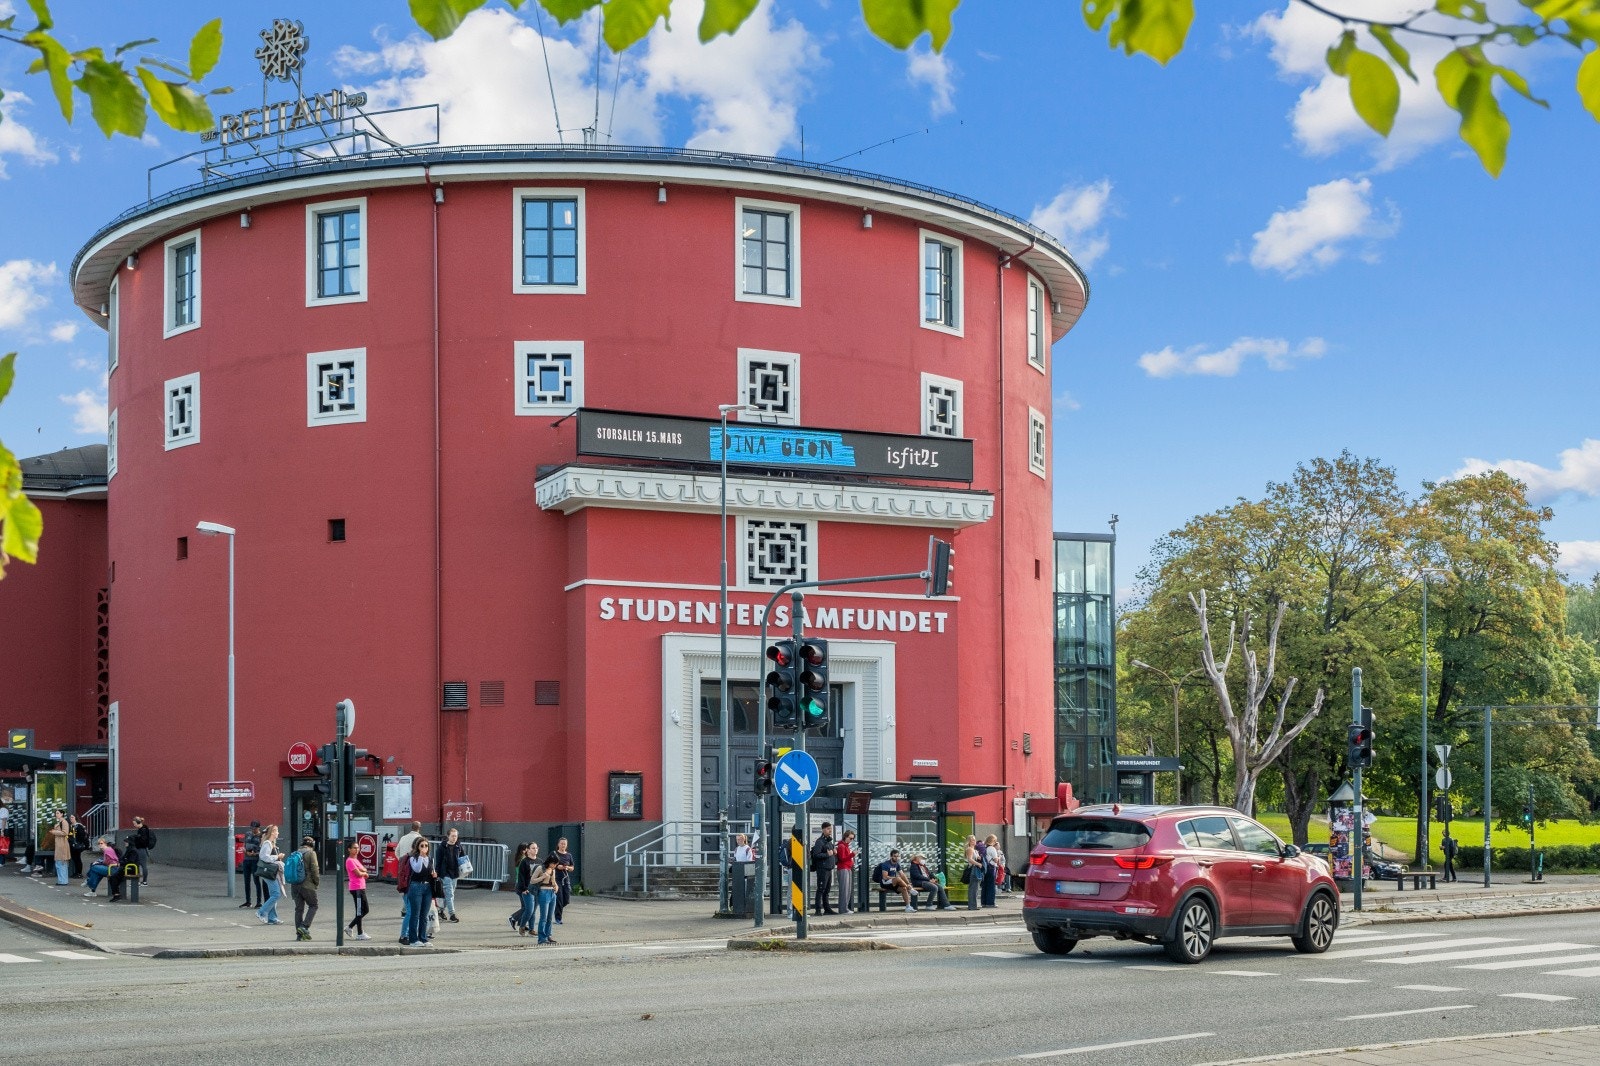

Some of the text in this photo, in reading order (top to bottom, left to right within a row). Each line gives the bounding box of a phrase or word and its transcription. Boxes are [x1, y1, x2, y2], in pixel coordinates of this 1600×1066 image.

[220, 89, 340, 145] REITAN
[597, 427, 642, 442] STORSALEN
[720, 433, 766, 454] DINA
